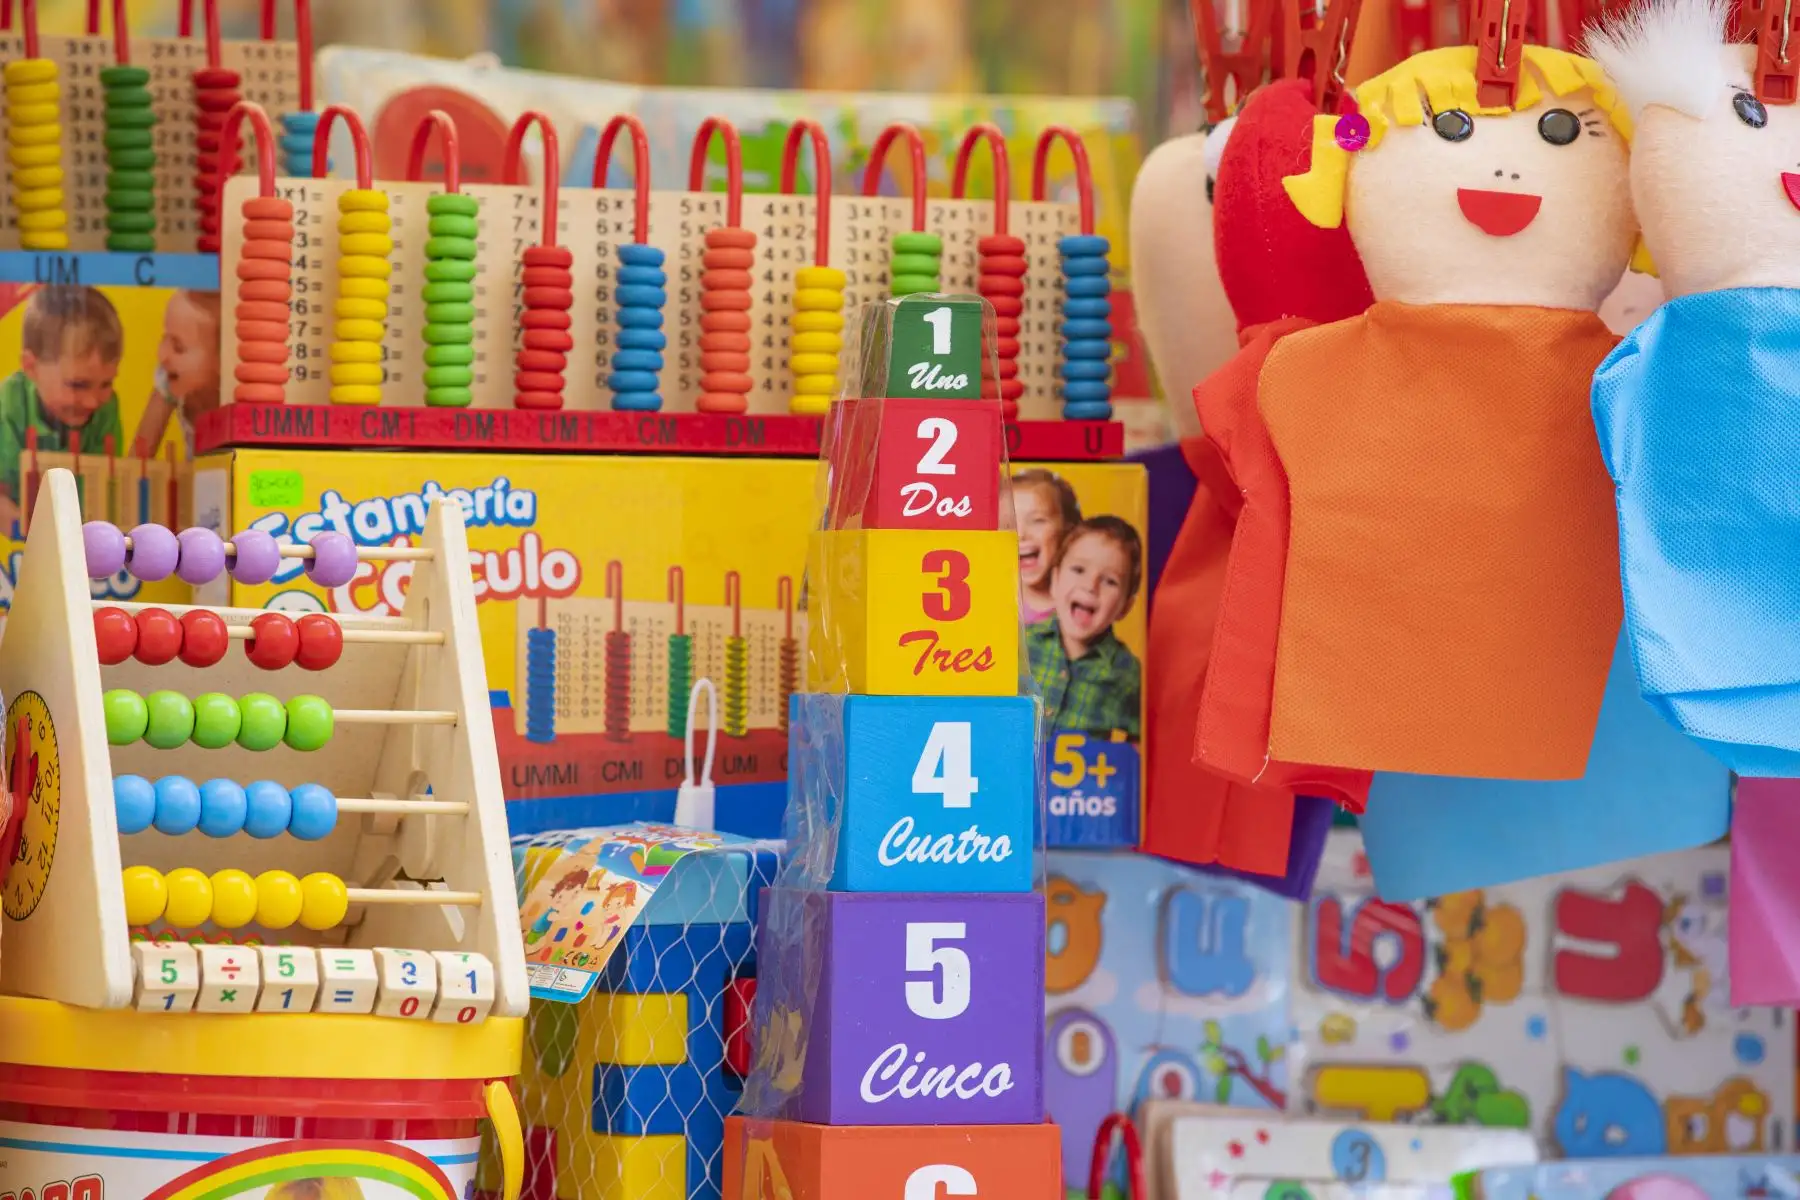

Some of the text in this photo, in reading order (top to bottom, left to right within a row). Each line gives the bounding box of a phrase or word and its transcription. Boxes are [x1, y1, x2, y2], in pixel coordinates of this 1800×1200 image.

[35, 256, 156, 286] UM C
[923, 306, 952, 355] 1
[907, 362, 968, 390] Uno
[637, 417, 678, 445] CM
[725, 418, 766, 447] DM
[1084, 426, 1103, 455] U
[916, 417, 958, 475] 2
[900, 481, 972, 517] Dos
[921, 549, 971, 621] 3
[898, 629, 996, 677] Tres
[512, 763, 579, 787] UMMI
[601, 760, 643, 782] CMI
[722, 754, 758, 775] UMI
[912, 721, 978, 808] 4
[1050, 734, 1117, 788] 5+
[1049, 790, 1117, 817] años
[877, 816, 1013, 867] Cuatro
[160, 958, 179, 985] 5
[277, 953, 297, 978] 5
[464, 969, 478, 995] 1
[905, 922, 971, 1020] 5
[162, 992, 177, 1011] 1
[280, 987, 294, 1009] 1
[859, 1044, 1014, 1104] Cinco
